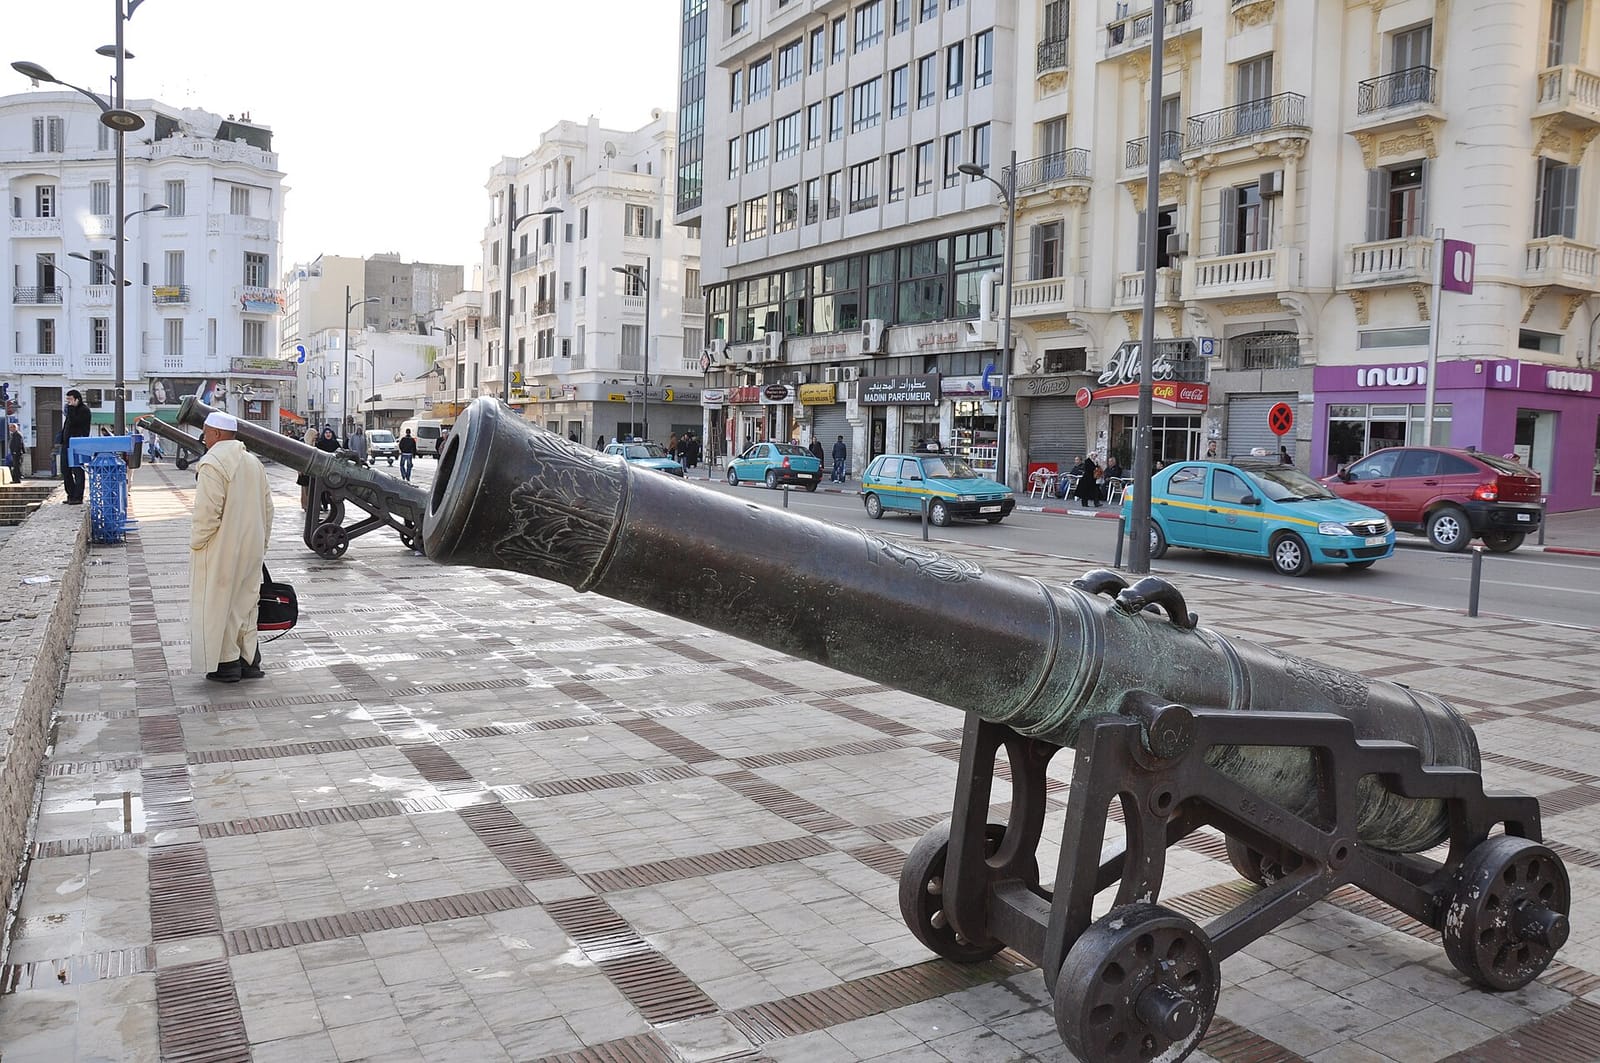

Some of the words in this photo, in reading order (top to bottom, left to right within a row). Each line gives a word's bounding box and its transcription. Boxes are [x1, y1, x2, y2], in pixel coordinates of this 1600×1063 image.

[864, 393, 887, 402] MADINI
[888, 391, 931, 402] PARFUMEUR
[1153, 386, 1174, 398] Café
